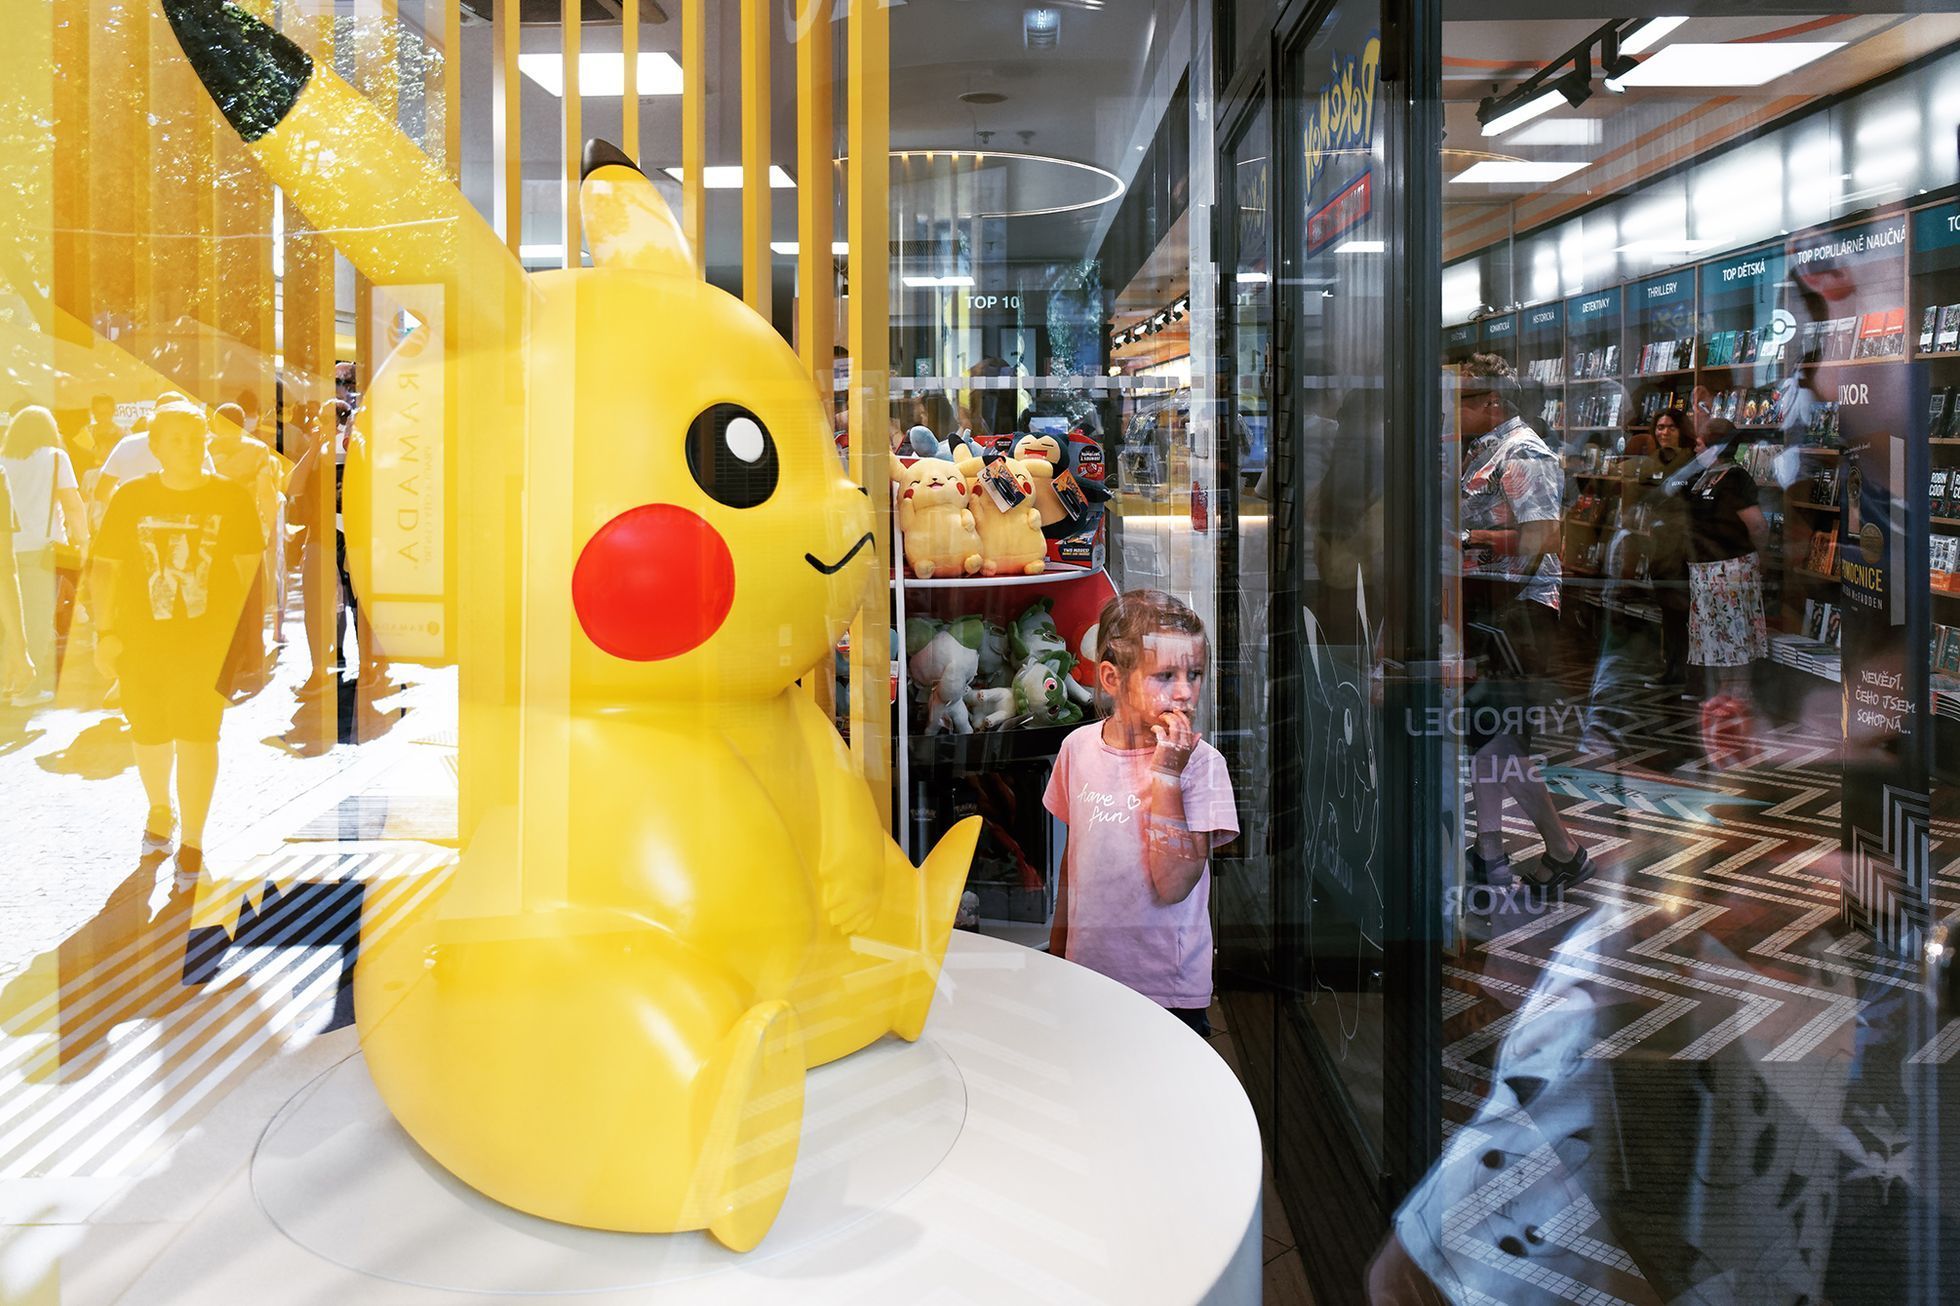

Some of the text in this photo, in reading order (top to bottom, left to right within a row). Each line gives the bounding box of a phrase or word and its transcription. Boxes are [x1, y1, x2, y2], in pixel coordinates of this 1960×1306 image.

[1797, 224, 1906, 265] TOP POPULÁRNĚ NAUČNÁ
[1722, 258, 1766, 281] TOP DĚTSKÁ
[1647, 281, 1677, 298] THRILLERY
[965, 295, 1020, 309] TOP 10
[1931, 472, 1949, 484] ROBIN
[1928, 484, 1946, 498] COOK
[1855, 685, 1917, 714] ČEHO JSEM
[1077, 782, 1116, 807] have
[1088, 804, 1131, 832] fun
